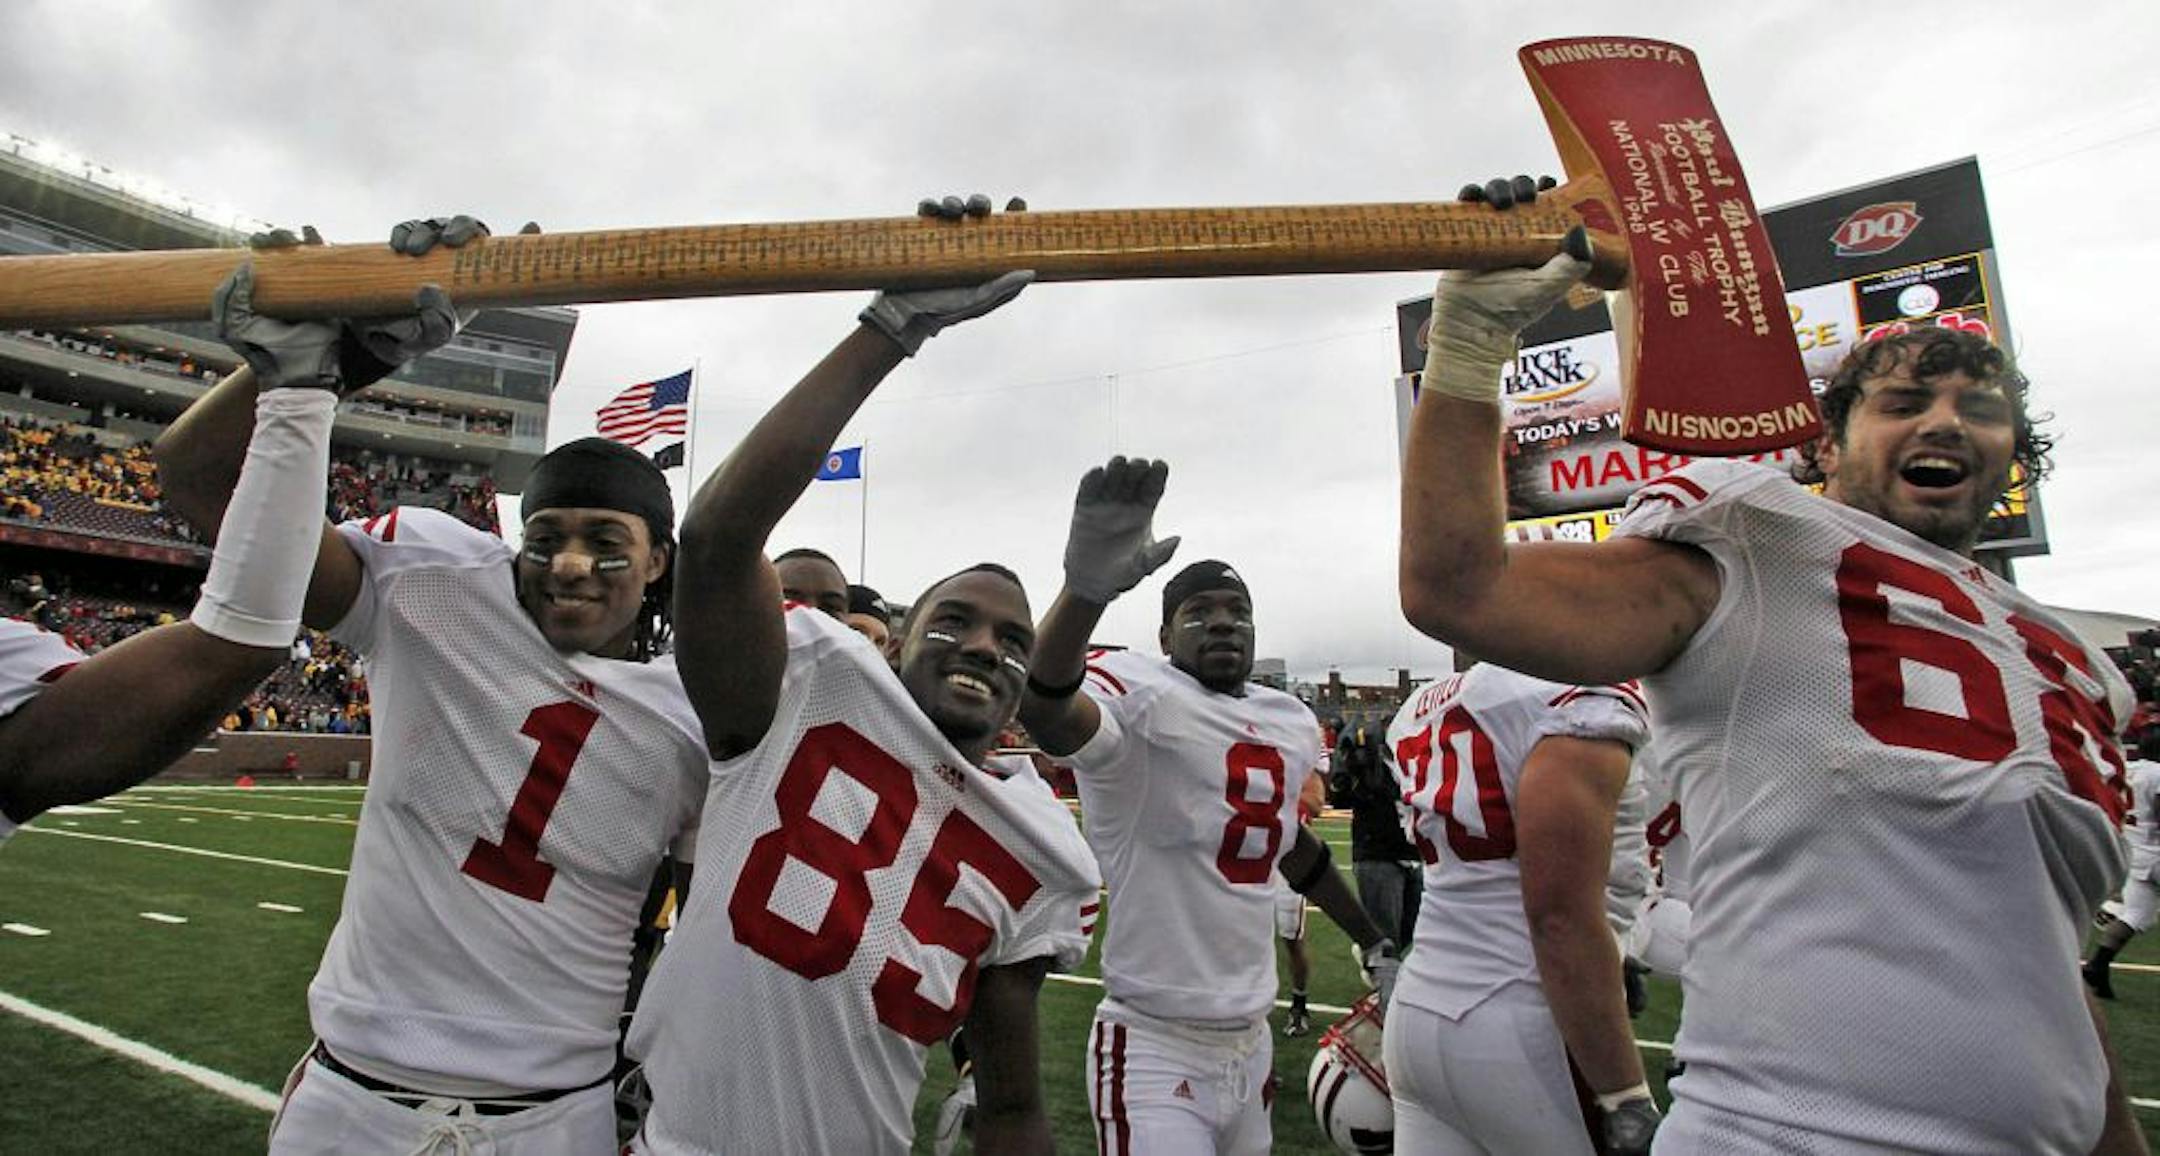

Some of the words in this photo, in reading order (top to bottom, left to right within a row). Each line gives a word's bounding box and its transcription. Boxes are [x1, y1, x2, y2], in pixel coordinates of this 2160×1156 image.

[1533, 42, 1684, 66] MINNESOTA
[1609, 119, 1660, 215] NATIONAL
[1623, 195, 1647, 234] 1948
[1648, 219, 1671, 245] W
[1658, 122, 1714, 229] FOOTBALL
[1704, 233, 1743, 327] TROPHY
[1676, 117, 1735, 187] Paul
[1718, 197, 1770, 336] Bunyan
[1849, 212, 1908, 246] DQ
[1659, 254, 1689, 318] CLUB
[1504, 362, 1585, 394] BANK
[1514, 417, 1601, 445] TODAY'S
[1644, 402, 1817, 440] WISCONSIN
[461, 699, 600, 903] 1
[1216, 741, 1285, 884] 8
[728, 720, 1043, 1047] 85
